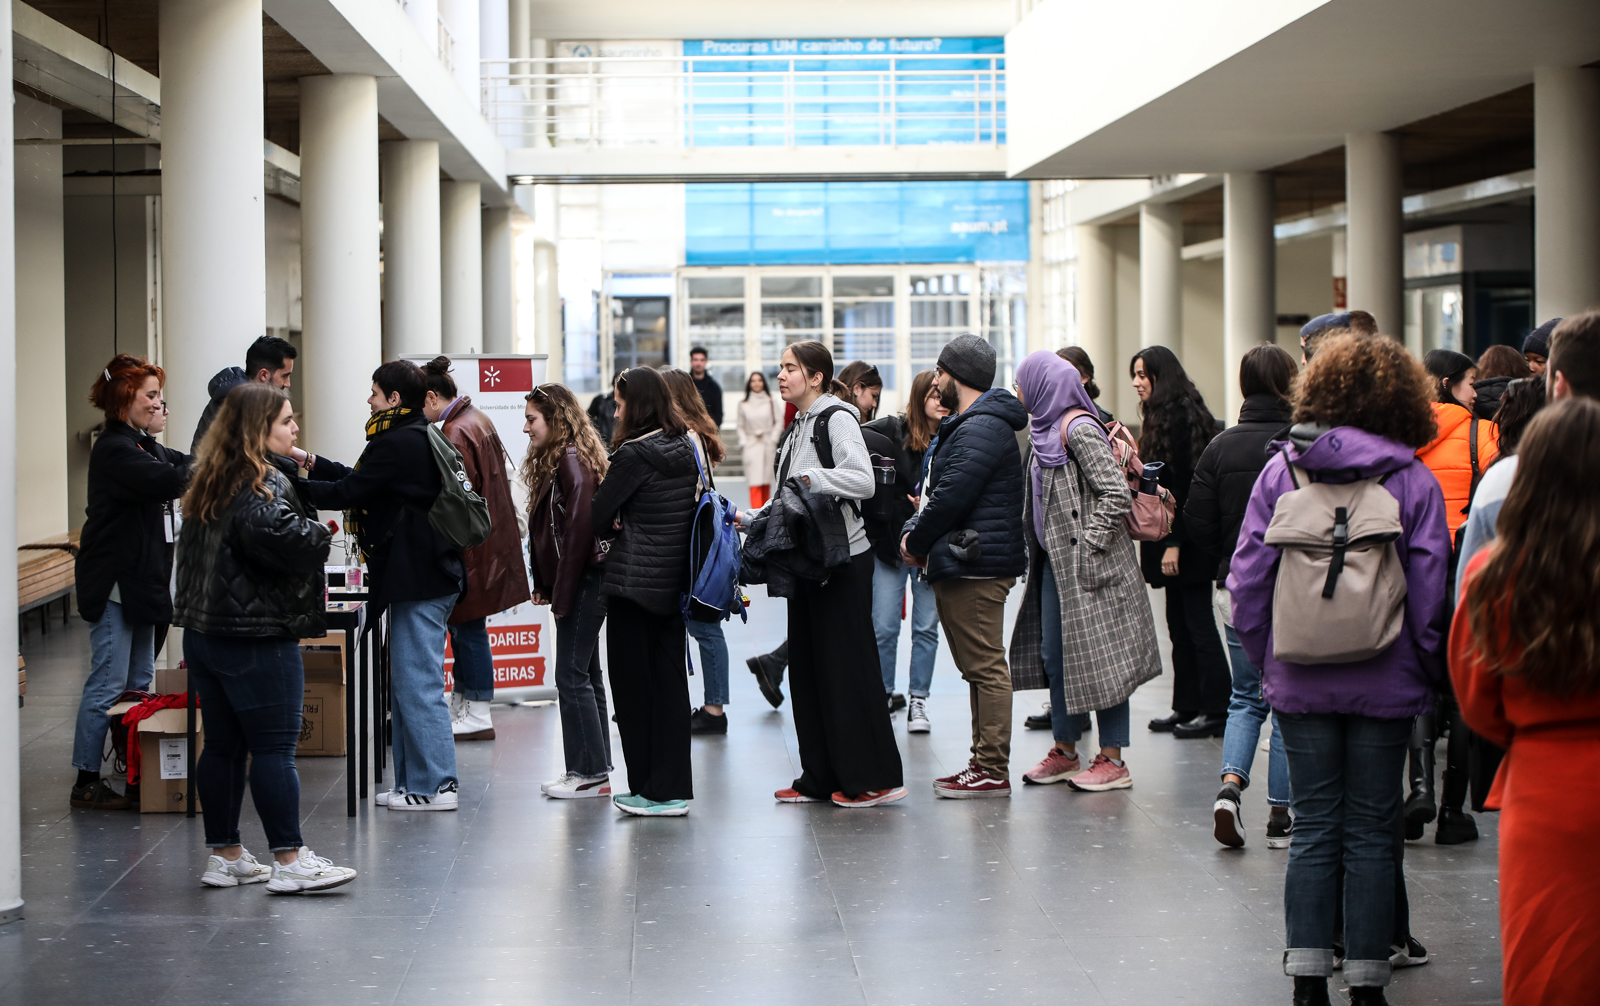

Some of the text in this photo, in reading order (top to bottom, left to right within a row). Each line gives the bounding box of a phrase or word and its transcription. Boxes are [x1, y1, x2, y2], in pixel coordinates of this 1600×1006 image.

[702, 37, 943, 53] Procuras UM caminho de futuro?
